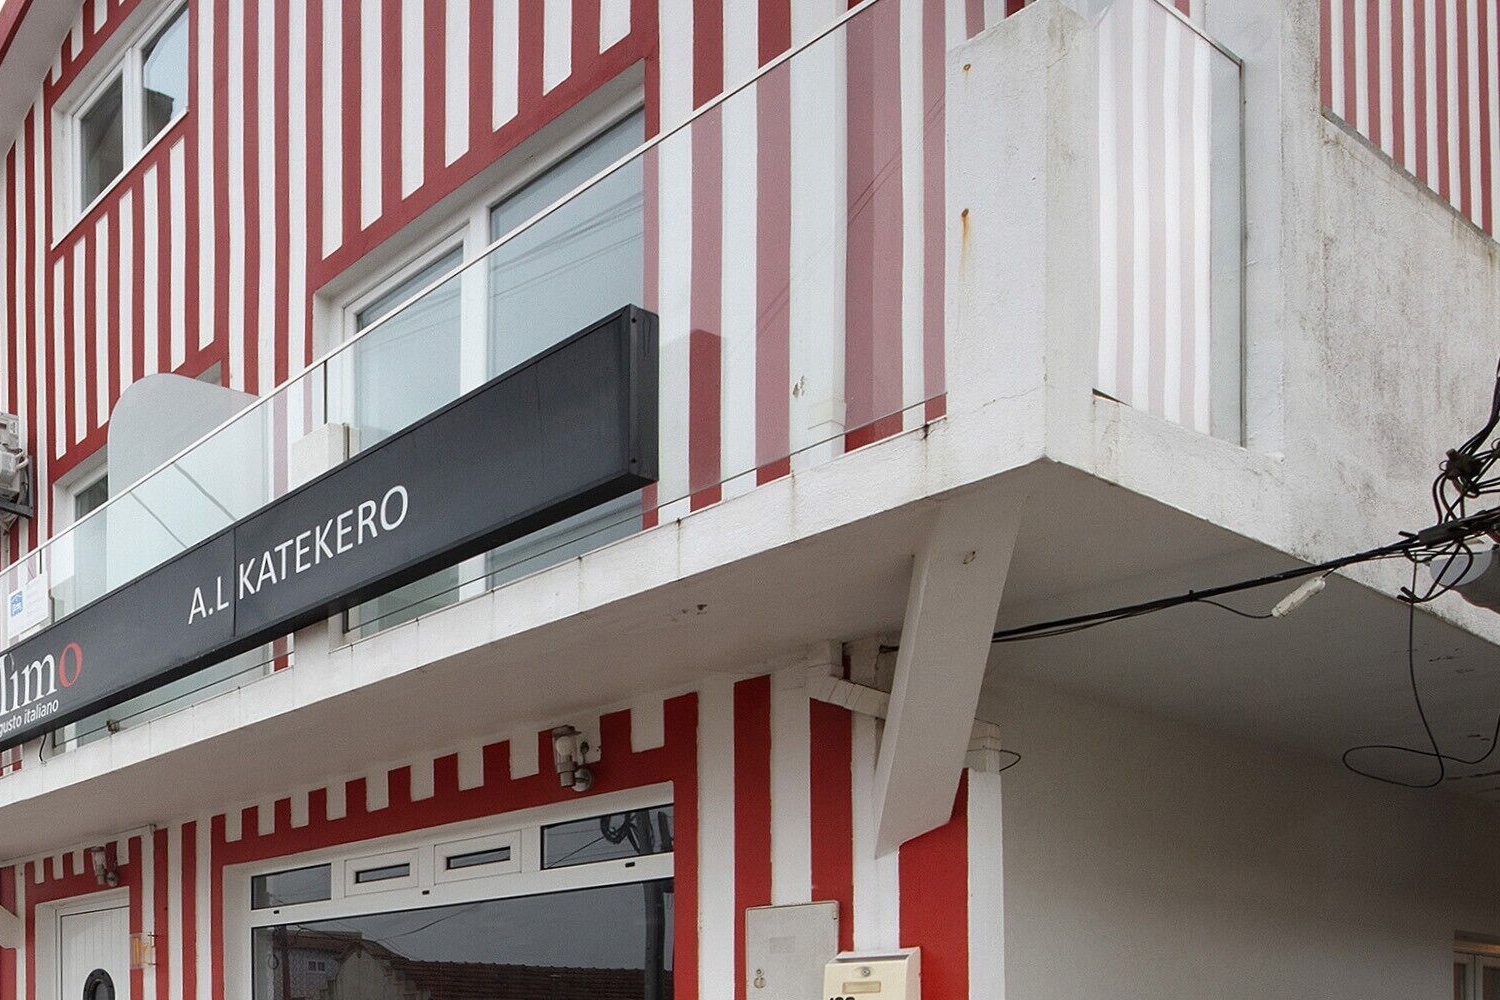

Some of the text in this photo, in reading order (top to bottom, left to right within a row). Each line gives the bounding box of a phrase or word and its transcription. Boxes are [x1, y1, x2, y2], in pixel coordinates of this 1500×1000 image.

[188, 485, 408, 625] A.L KATEKERO
[23, 699, 59, 724] italiano
